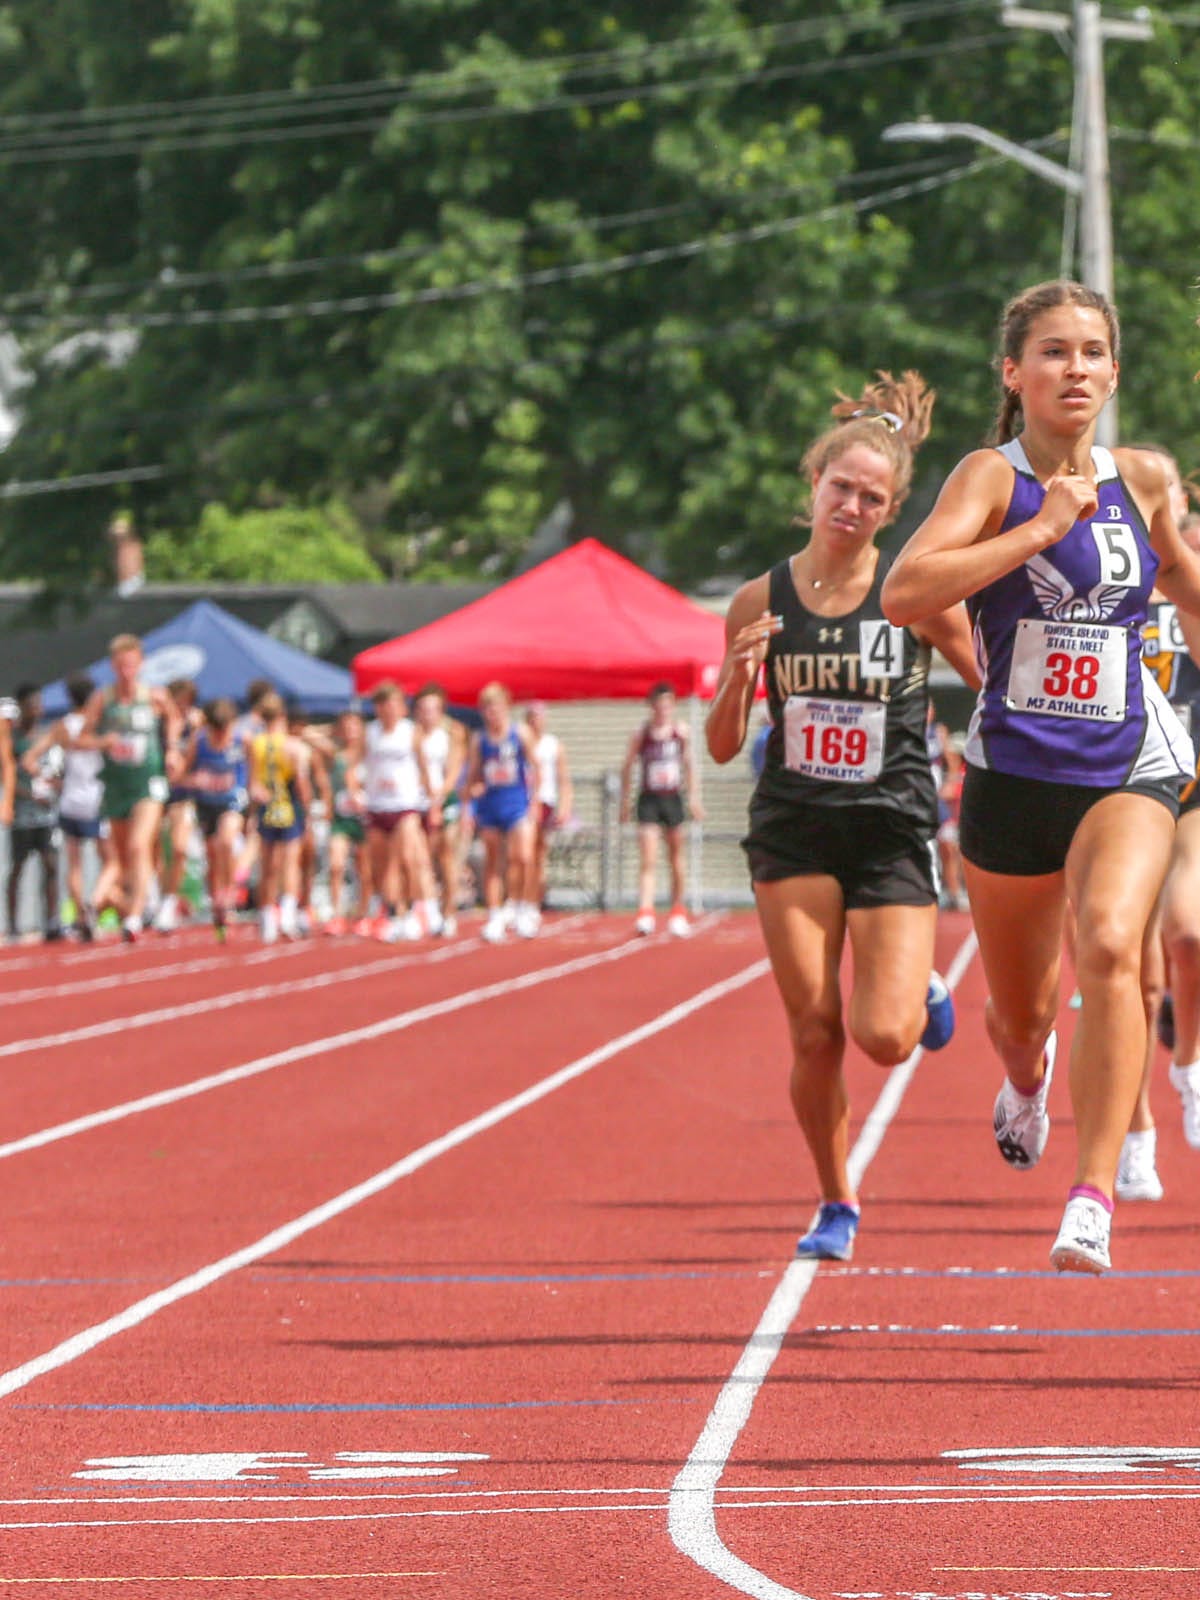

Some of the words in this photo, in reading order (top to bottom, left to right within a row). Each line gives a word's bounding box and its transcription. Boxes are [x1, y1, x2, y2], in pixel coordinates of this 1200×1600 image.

[1103, 528, 1132, 582] 5
[1043, 624, 1075, 638] RHODE
[1046, 637, 1077, 651] STATE
[1079, 640, 1105, 653] MEET
[869, 624, 895, 673] 4
[1043, 652, 1100, 700] 38
[1047, 700, 1108, 717] ATHLETIC
[801, 724, 868, 766] 169
[814, 766, 865, 779] ATHLETIC
